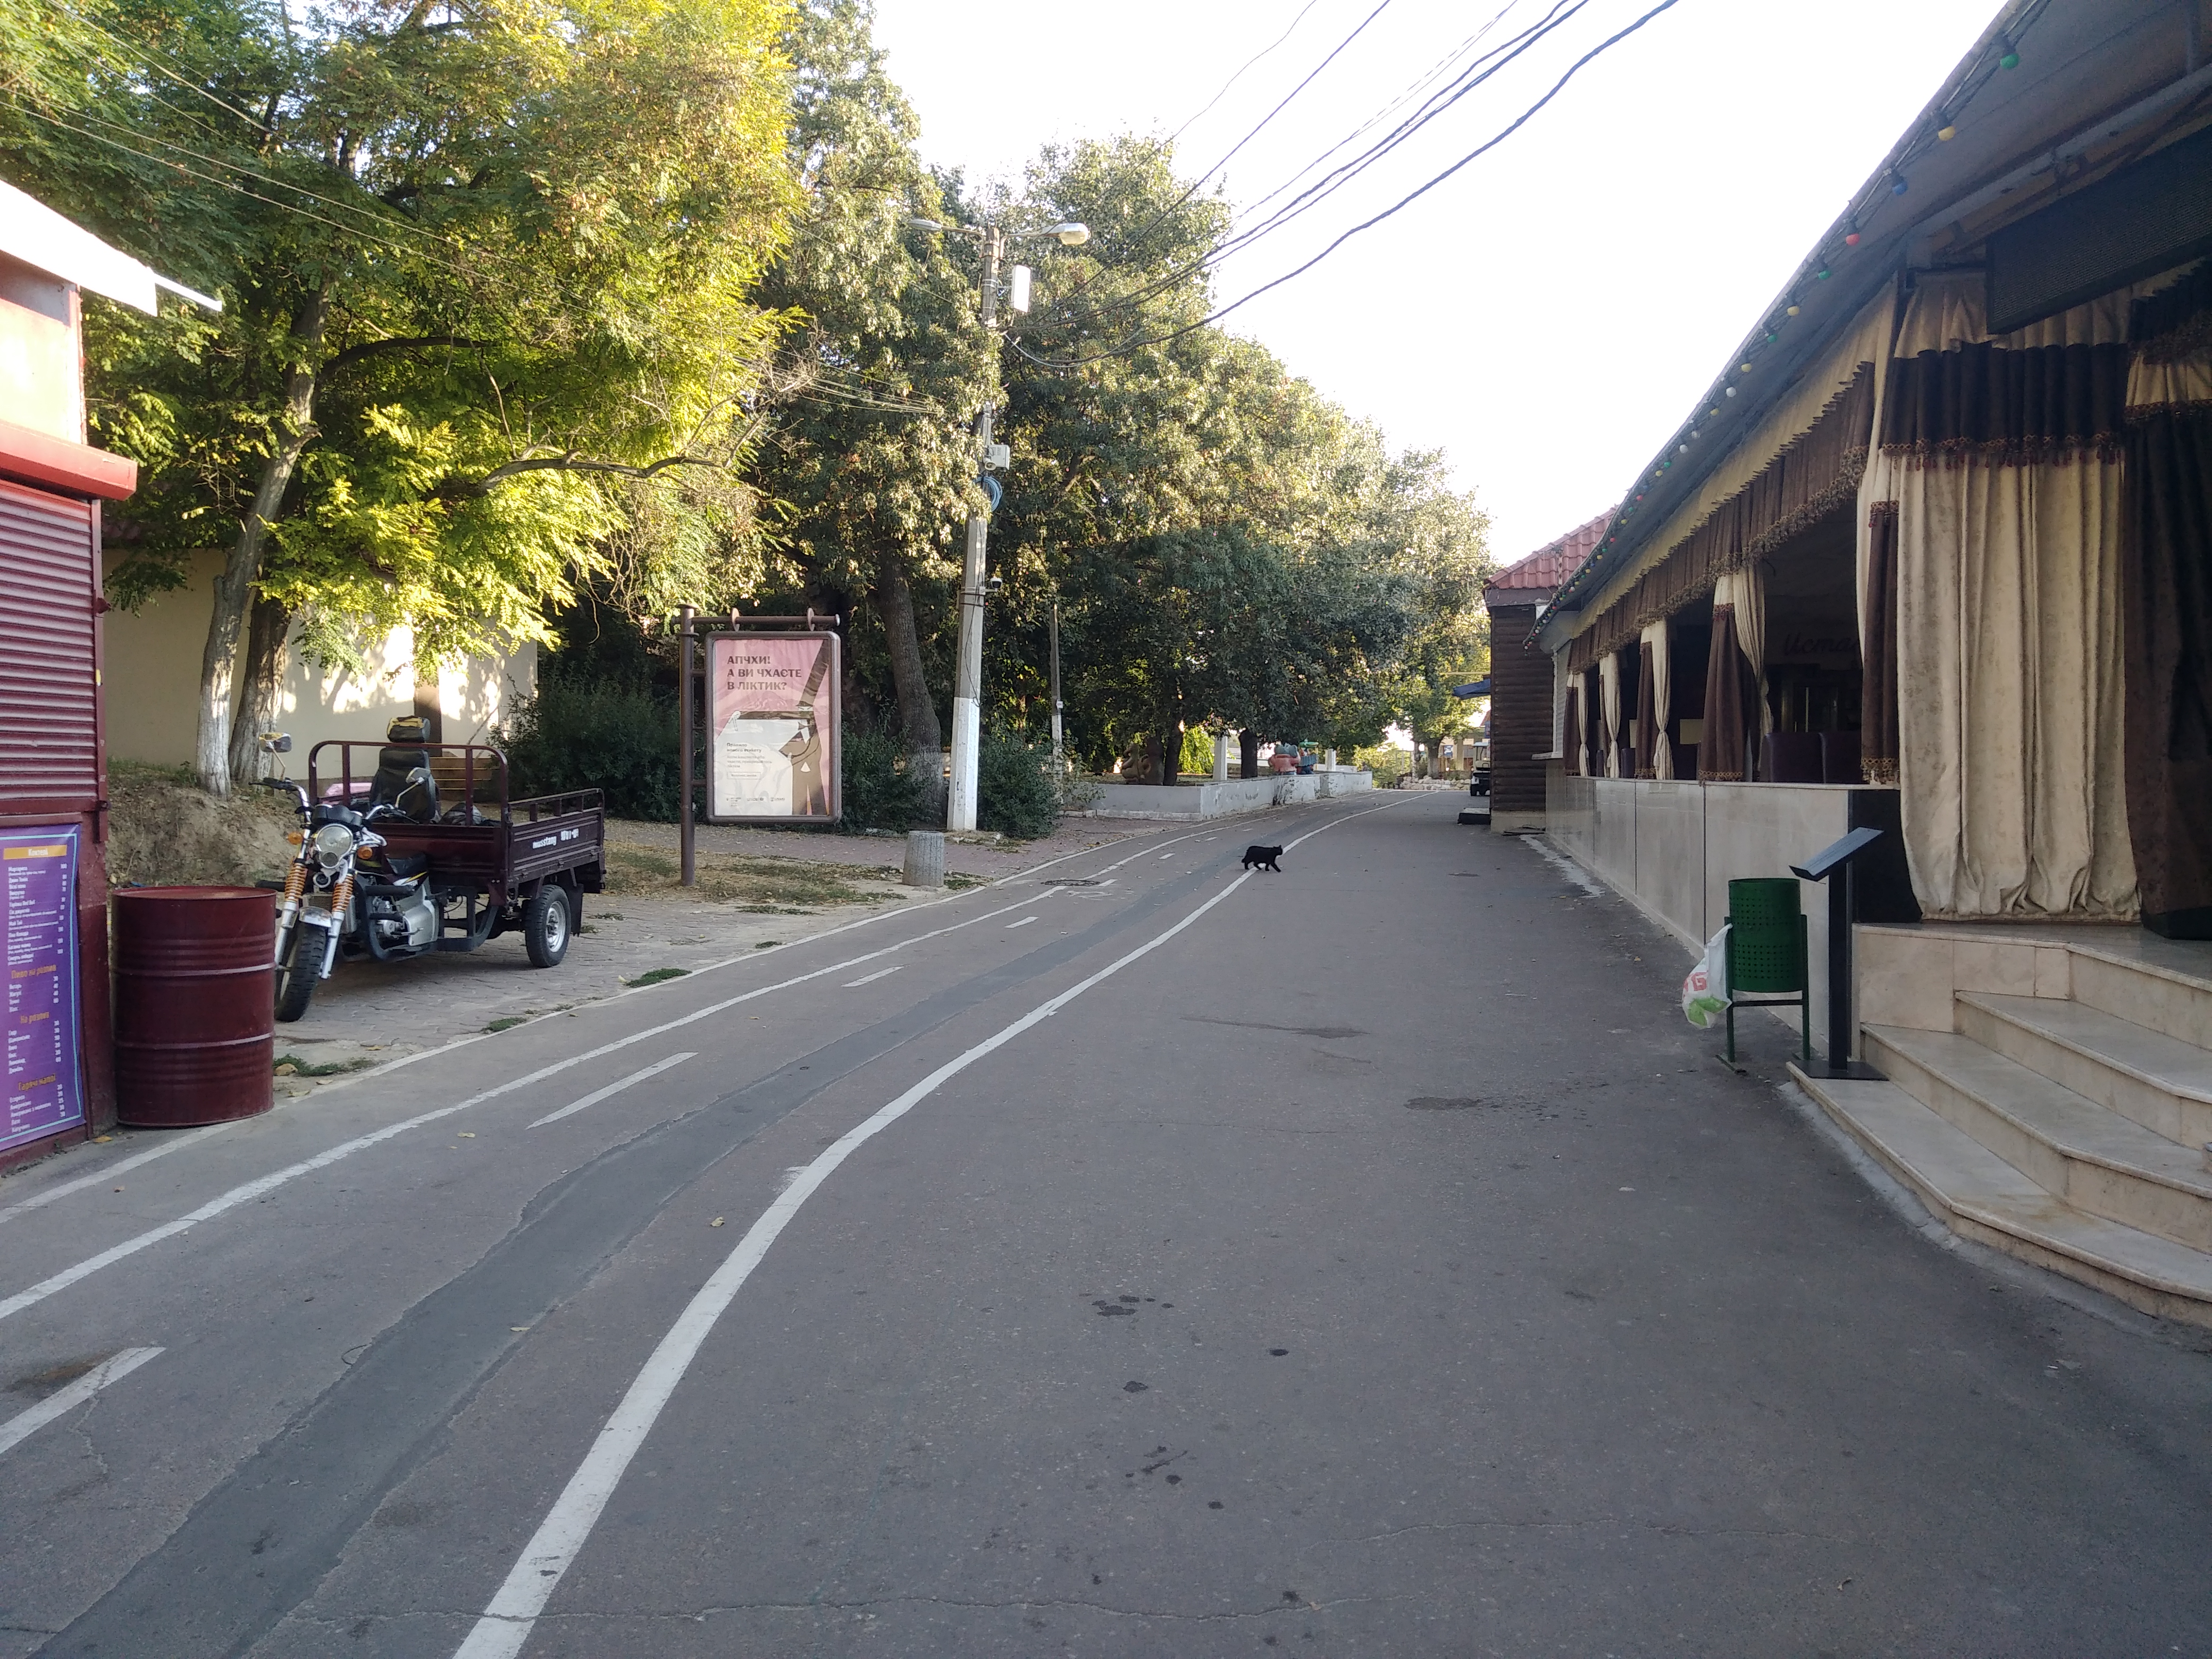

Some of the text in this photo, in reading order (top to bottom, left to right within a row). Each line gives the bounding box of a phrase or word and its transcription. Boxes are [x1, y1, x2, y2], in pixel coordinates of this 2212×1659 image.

[727, 656, 771, 665] АПЧХИ!
[727, 669, 802, 677] А ВИ ЧХАЄТЕ
[727, 681, 787, 690] В ЛІКТИК?
